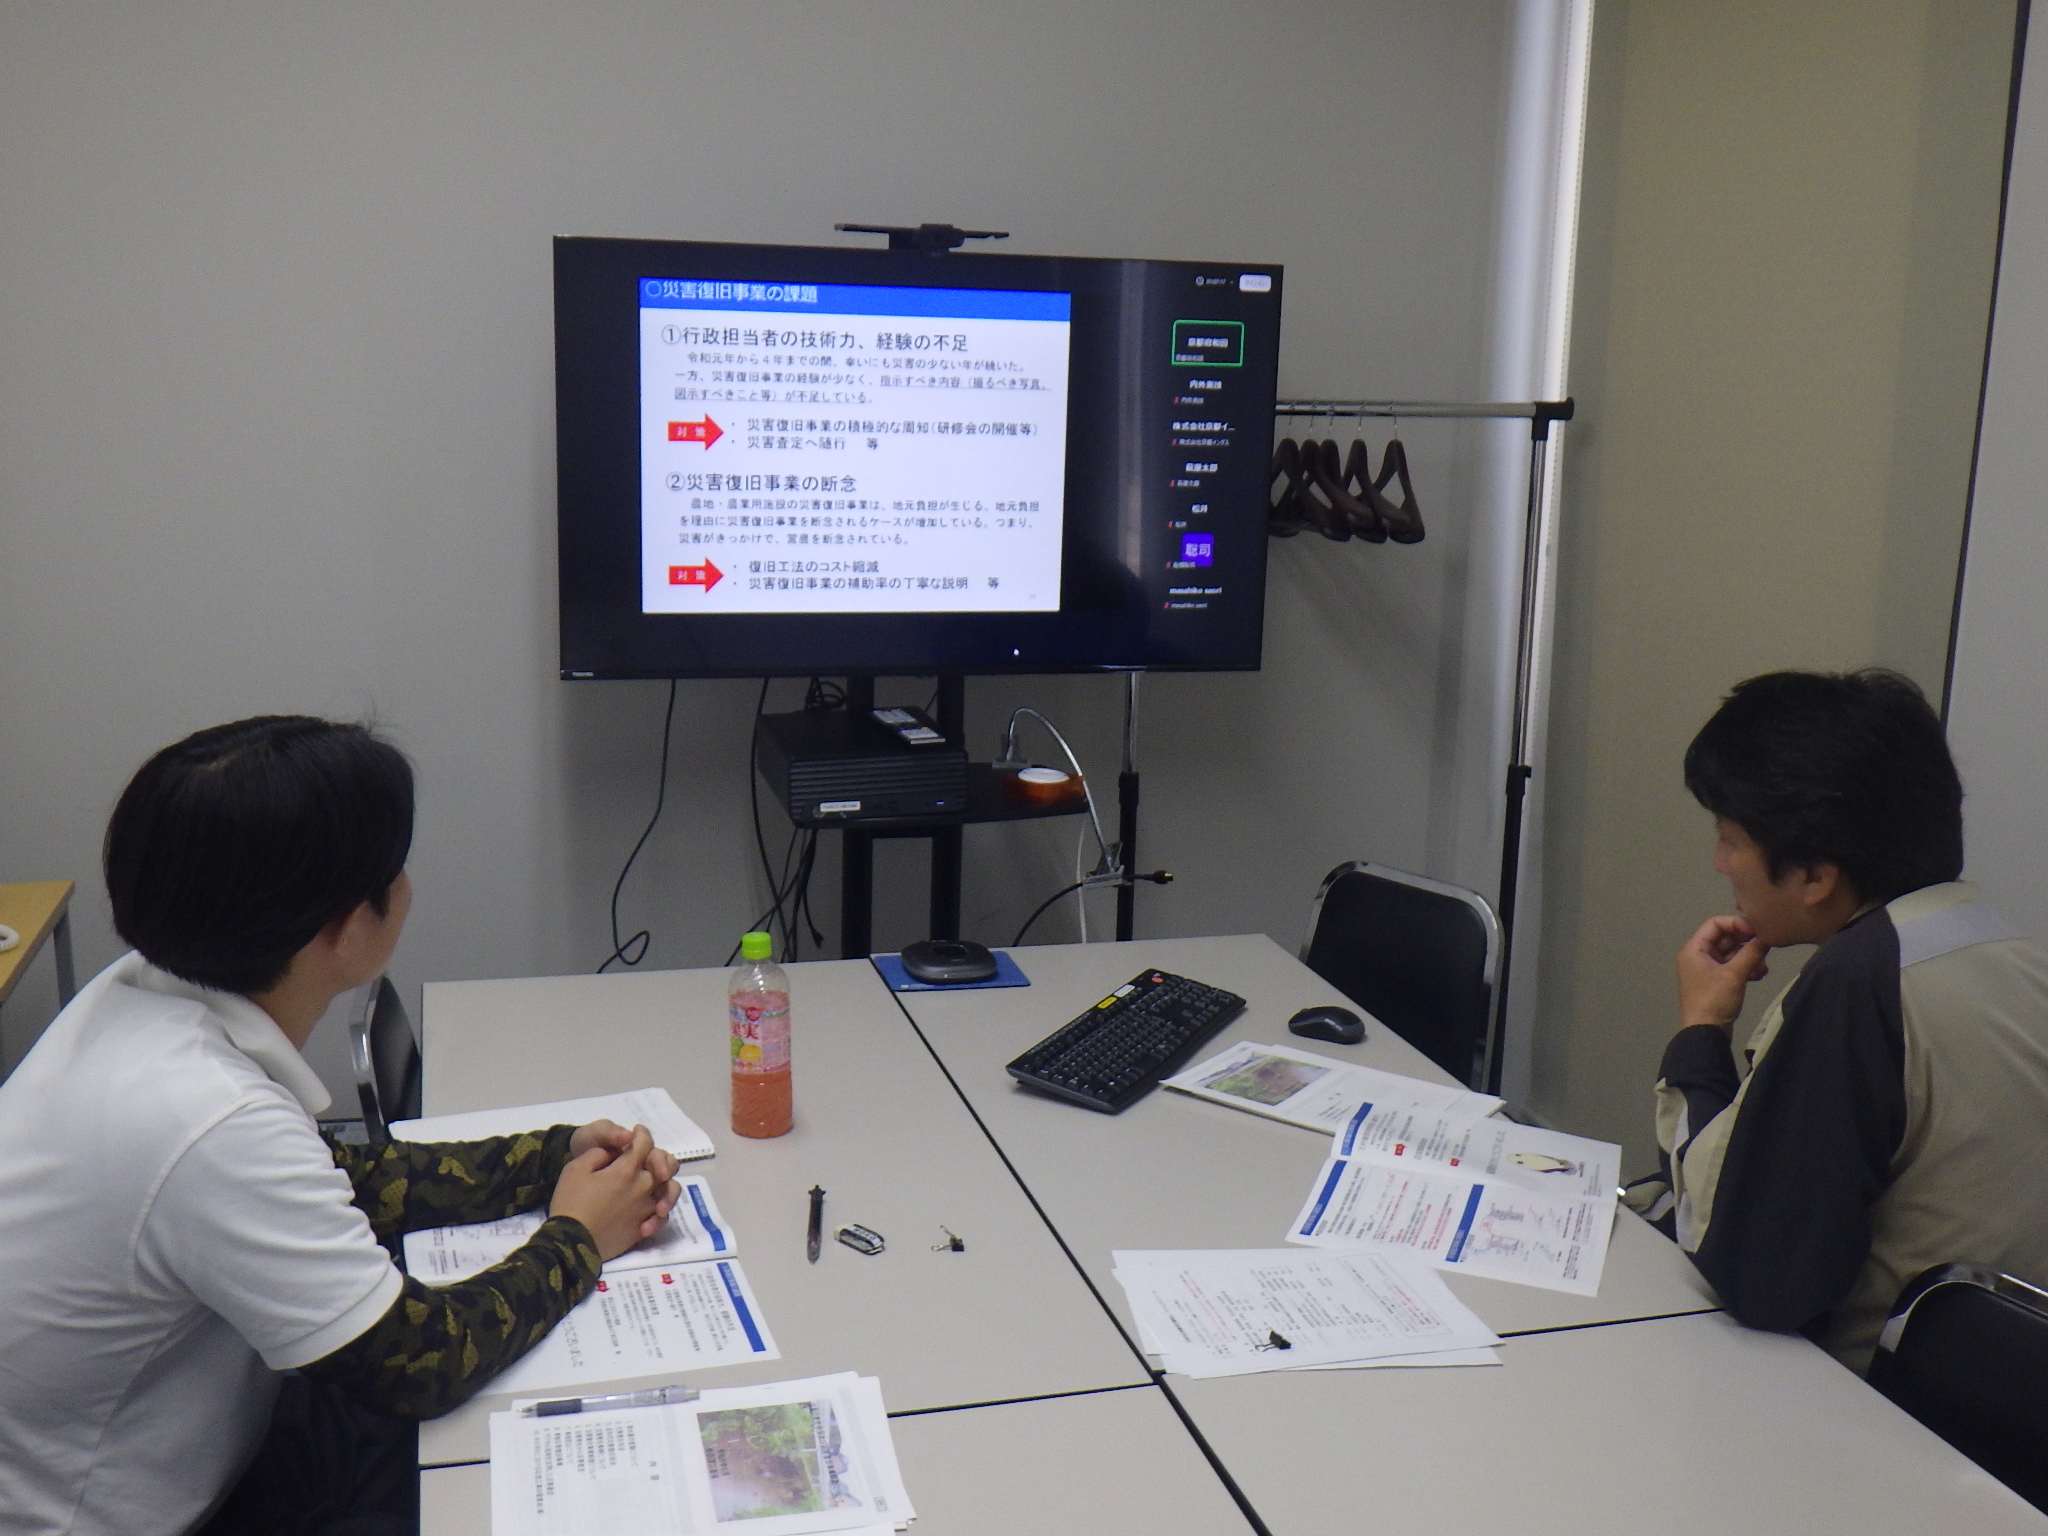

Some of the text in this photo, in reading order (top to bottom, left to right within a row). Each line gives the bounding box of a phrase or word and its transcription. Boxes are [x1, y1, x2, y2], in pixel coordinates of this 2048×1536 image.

[665, 471, 857, 493] ②災害復旧事業の断念
